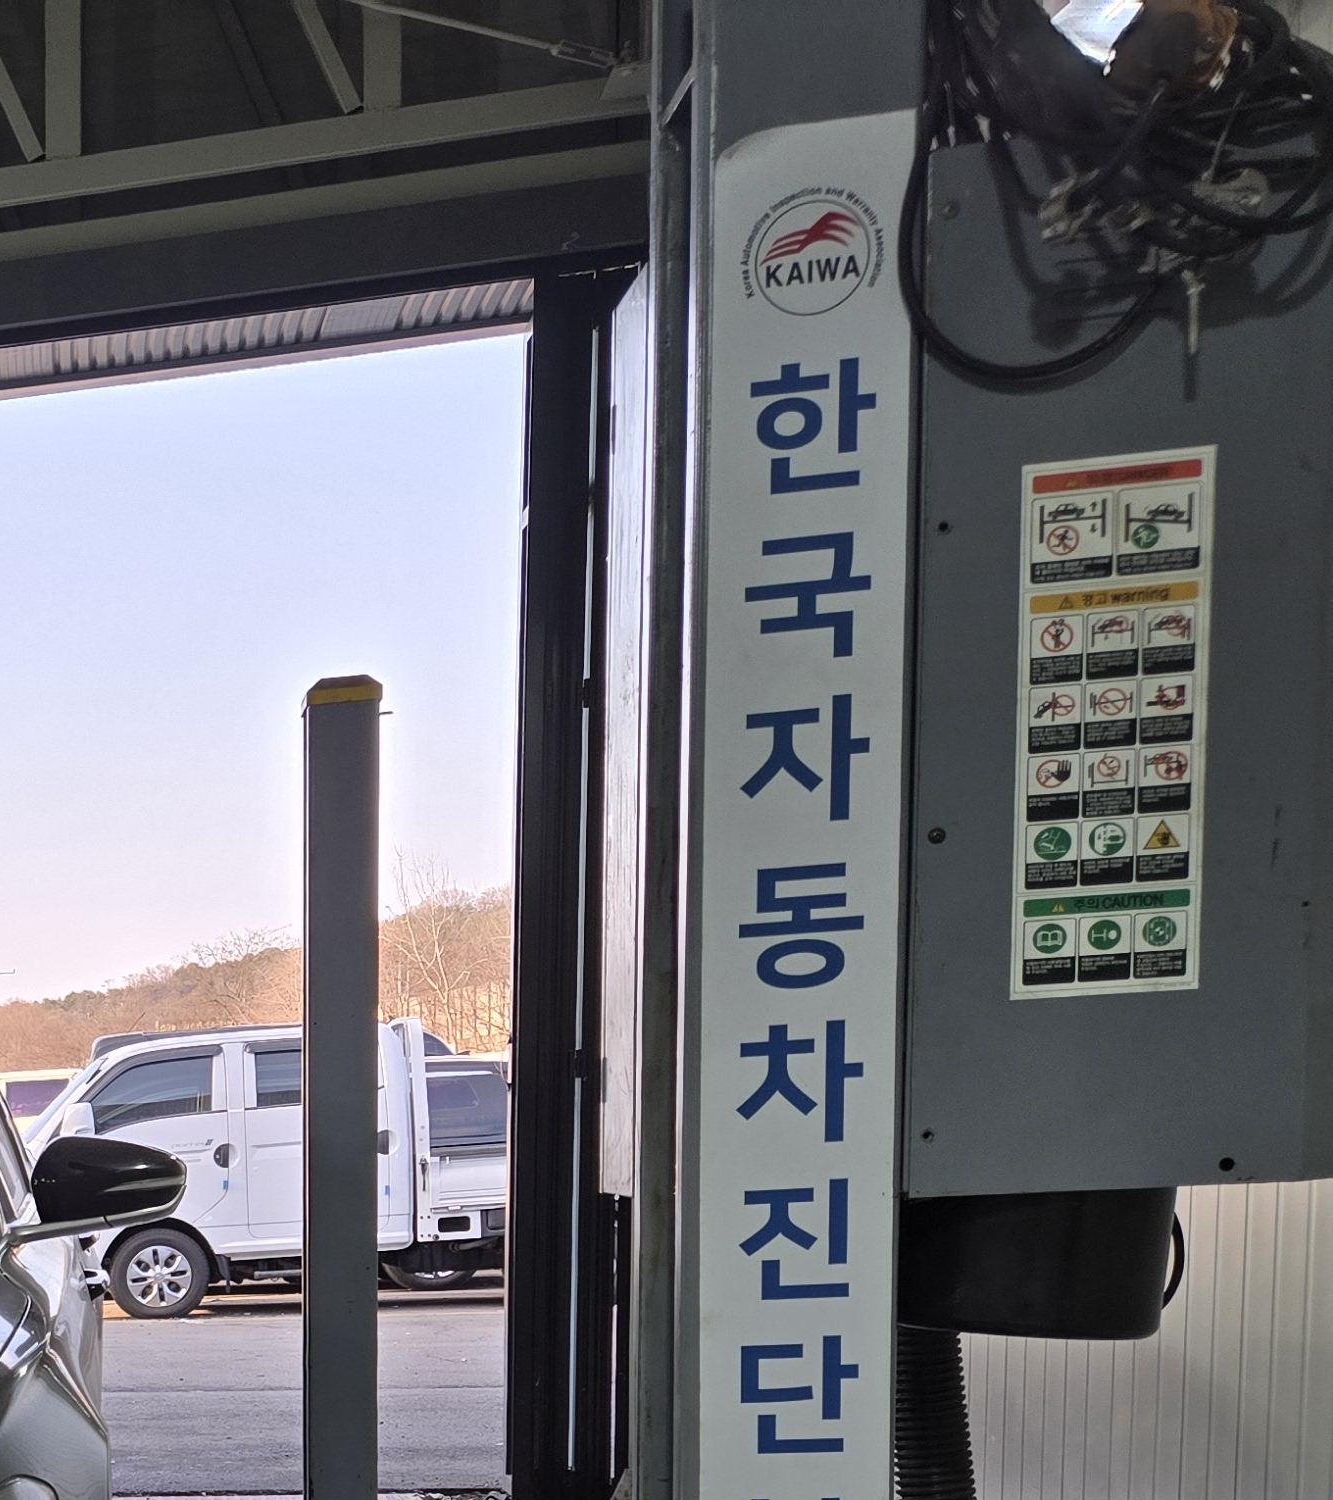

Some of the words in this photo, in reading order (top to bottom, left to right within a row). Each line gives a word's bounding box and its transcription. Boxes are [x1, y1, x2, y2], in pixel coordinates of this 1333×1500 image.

[824, 187, 846, 198] and
[740, 212, 771, 267] Automotive
[765, 255, 861, 288] KAIWA
[741, 269, 756, 299] Korea
[1110, 587, 1171, 603] warning
[1102, 894, 1164, 910] CAUTION
